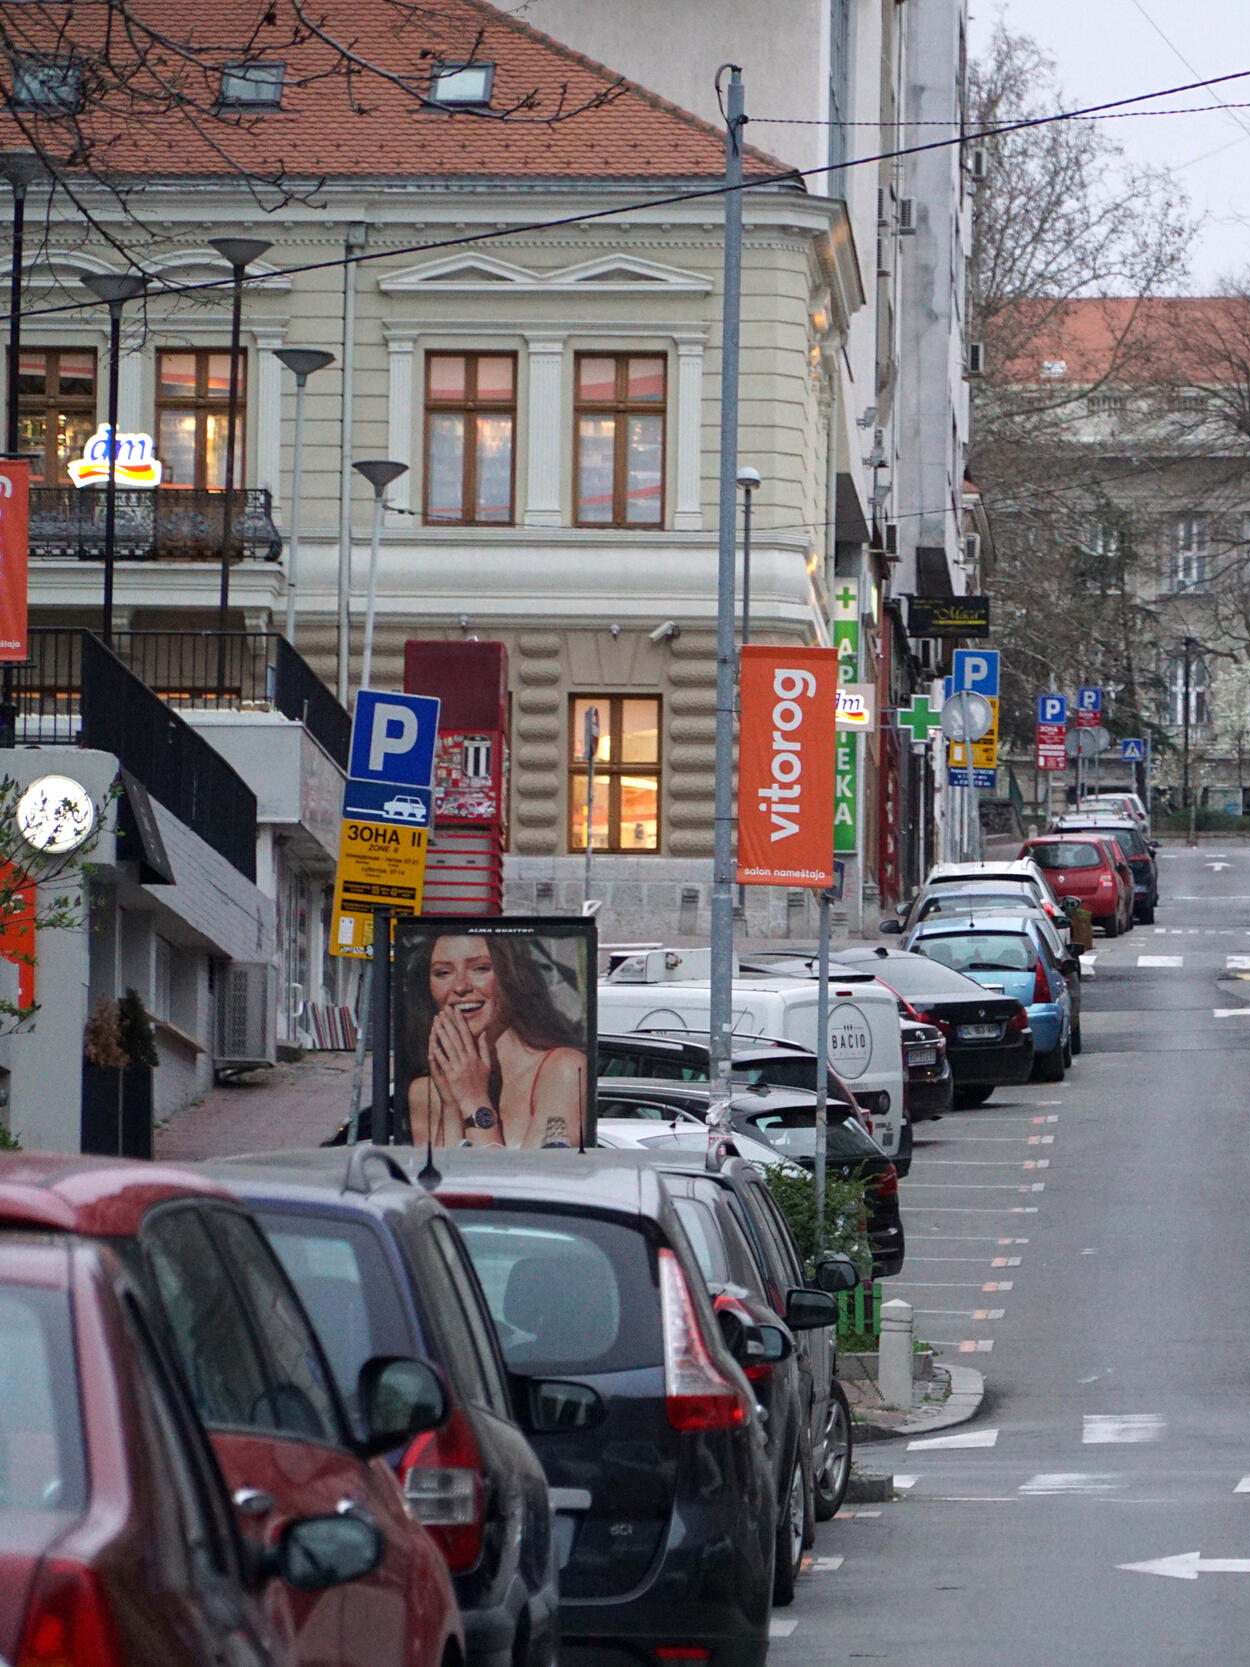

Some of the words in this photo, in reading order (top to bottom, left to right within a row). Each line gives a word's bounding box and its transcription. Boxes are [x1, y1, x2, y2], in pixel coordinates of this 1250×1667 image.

[90, 429, 146, 461] dm
[964, 657, 988, 689] P
[1045, 699, 1061, 720] P
[369, 702, 419, 772] P
[834, 637, 855, 826] APEKA
[757, 667, 817, 843] vitorog
[347, 825, 400, 845] ЗОНА
[744, 867, 771, 876] salon
[773, 868, 826, 881] nameštaja
[832, 1033, 866, 1049] BACIO
